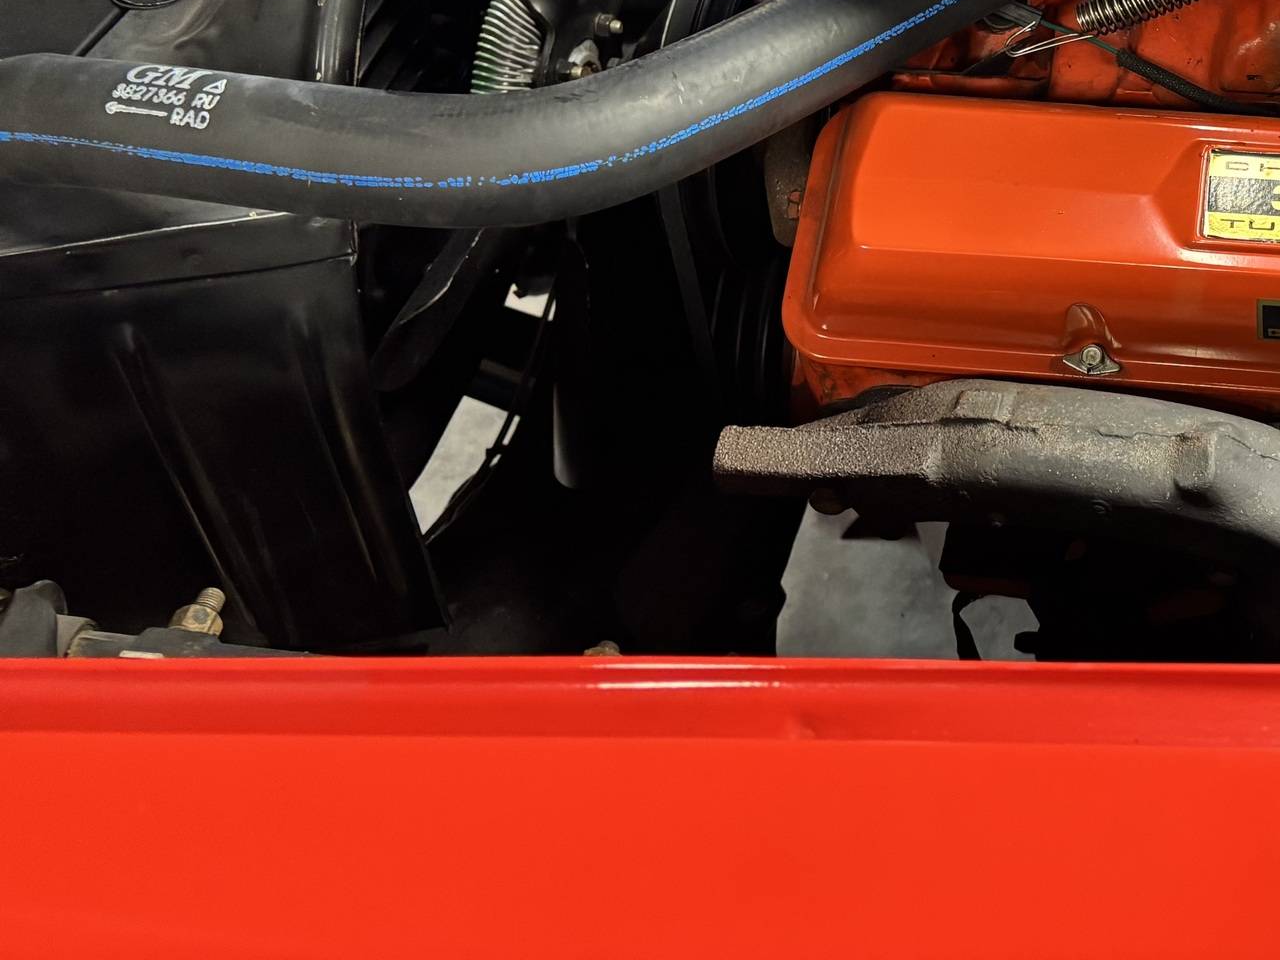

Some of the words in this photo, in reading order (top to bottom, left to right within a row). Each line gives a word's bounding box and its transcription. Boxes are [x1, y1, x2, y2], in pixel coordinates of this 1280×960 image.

[127, 64, 213, 89] GM
[191, 93, 221, 110] RU
[170, 107, 210, 129] RAD
